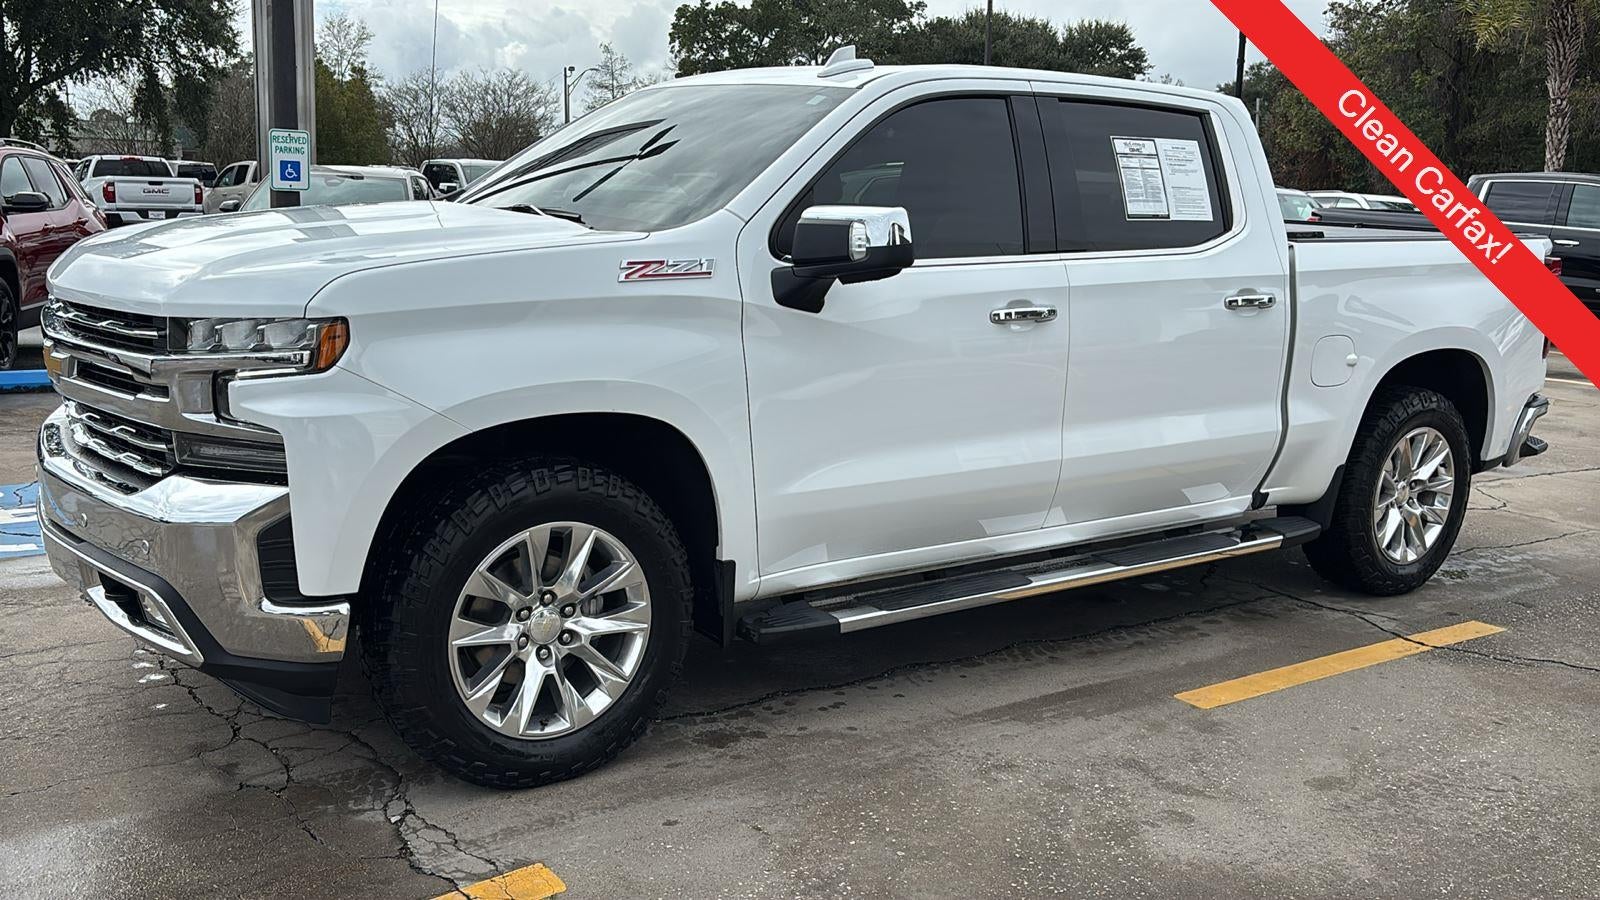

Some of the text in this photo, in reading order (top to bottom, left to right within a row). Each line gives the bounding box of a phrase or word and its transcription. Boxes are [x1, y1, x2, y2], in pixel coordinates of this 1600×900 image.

[272, 135, 307, 144] RESERVED
[275, 146, 305, 155] PARKING
[618, 258, 715, 282] Z71
